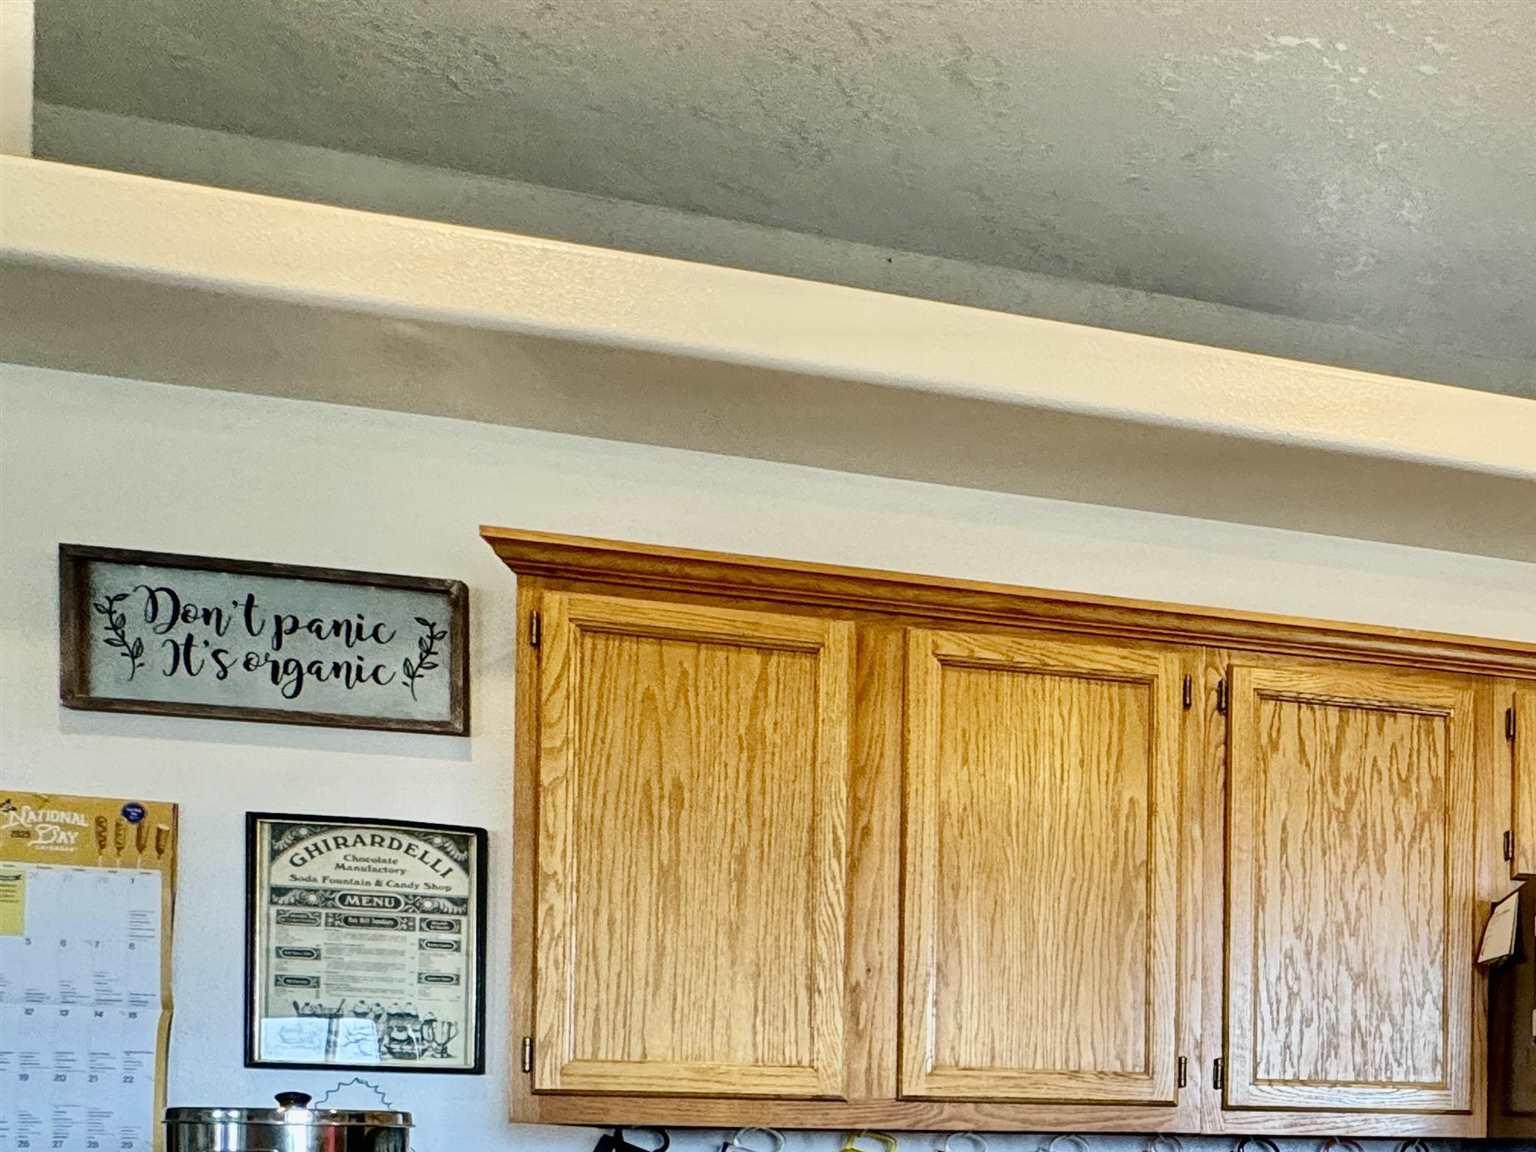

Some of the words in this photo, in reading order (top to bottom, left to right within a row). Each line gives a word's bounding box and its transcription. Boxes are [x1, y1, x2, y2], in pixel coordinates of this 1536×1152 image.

[133, 584, 265, 637] Don't
[272, 615, 397, 651] panic
[162, 633, 237, 680] It's
[243, 649, 397, 700] organic
[288, 833, 455, 878] GHIRARDELLI
[343, 853, 399, 866] Chocolate
[334, 862, 407, 876] Manufactory
[289, 873, 318, 884] Soda
[321, 875, 372, 888] Fountain
[374, 878, 383, 888] &
[386, 879, 421, 891] Candy
[423, 882, 453, 893] Shop
[344, 894, 397, 909] MENU
[18, 1073, 30, 1082] 19
[53, 1074, 67, 1083] 20
[87, 1075, 99, 1083] 21
[122, 1075, 135, 1084] 22
[52, 1139, 64, 1149] 27
